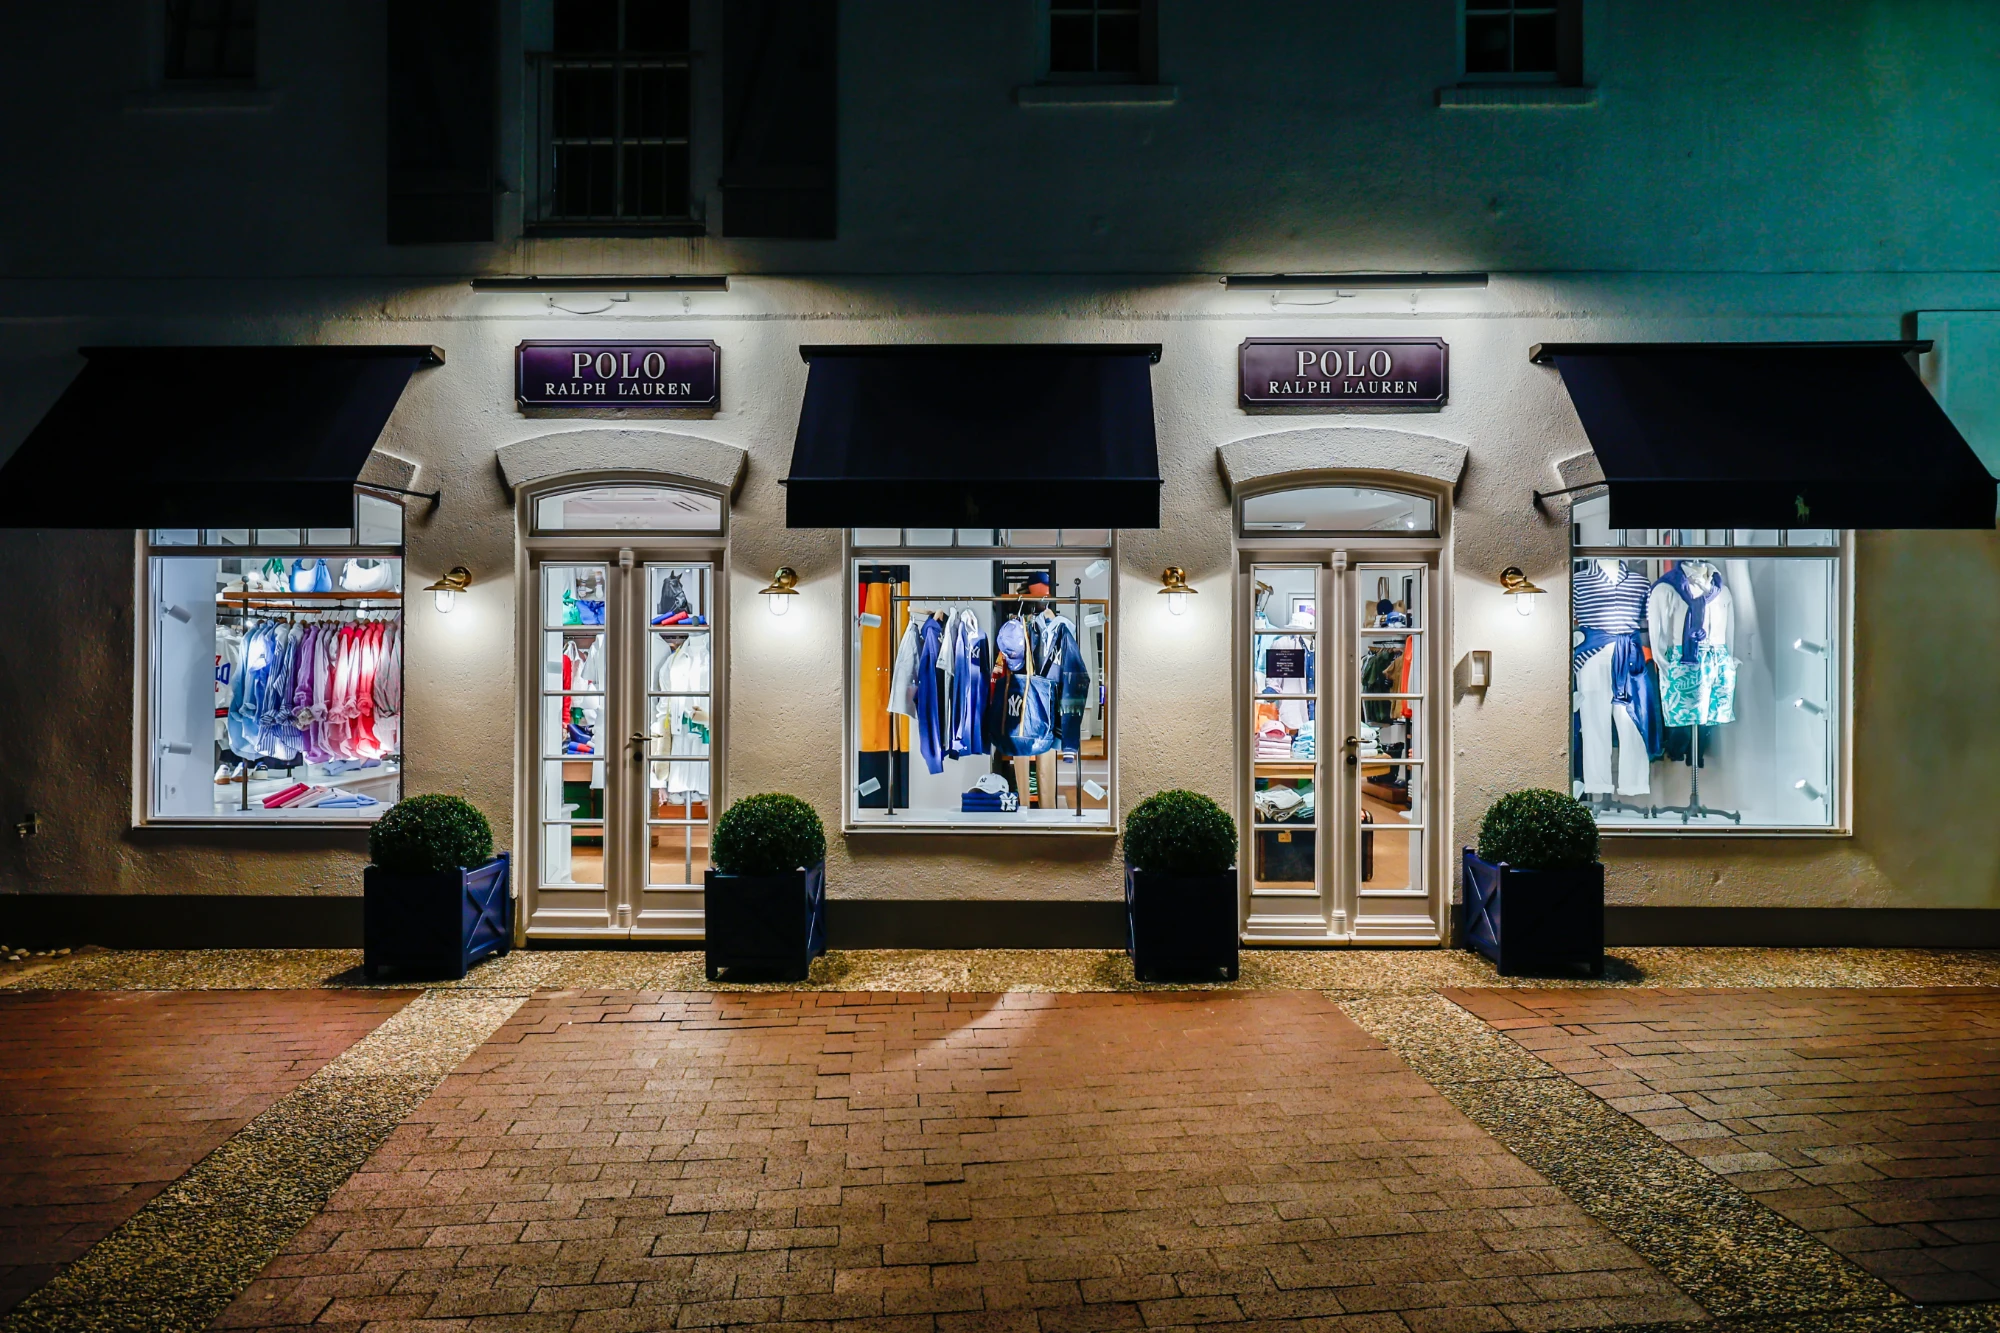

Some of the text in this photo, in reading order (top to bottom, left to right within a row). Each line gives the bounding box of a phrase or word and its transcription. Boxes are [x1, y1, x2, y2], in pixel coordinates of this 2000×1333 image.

[572, 352, 666, 379] POLO
[1296, 350, 1392, 377] POLO
[545, 383, 691, 395] RALPH LAUREN
[1268, 381, 1418, 394] RALPH LAUREN
[1008, 694, 1023, 716] NY
